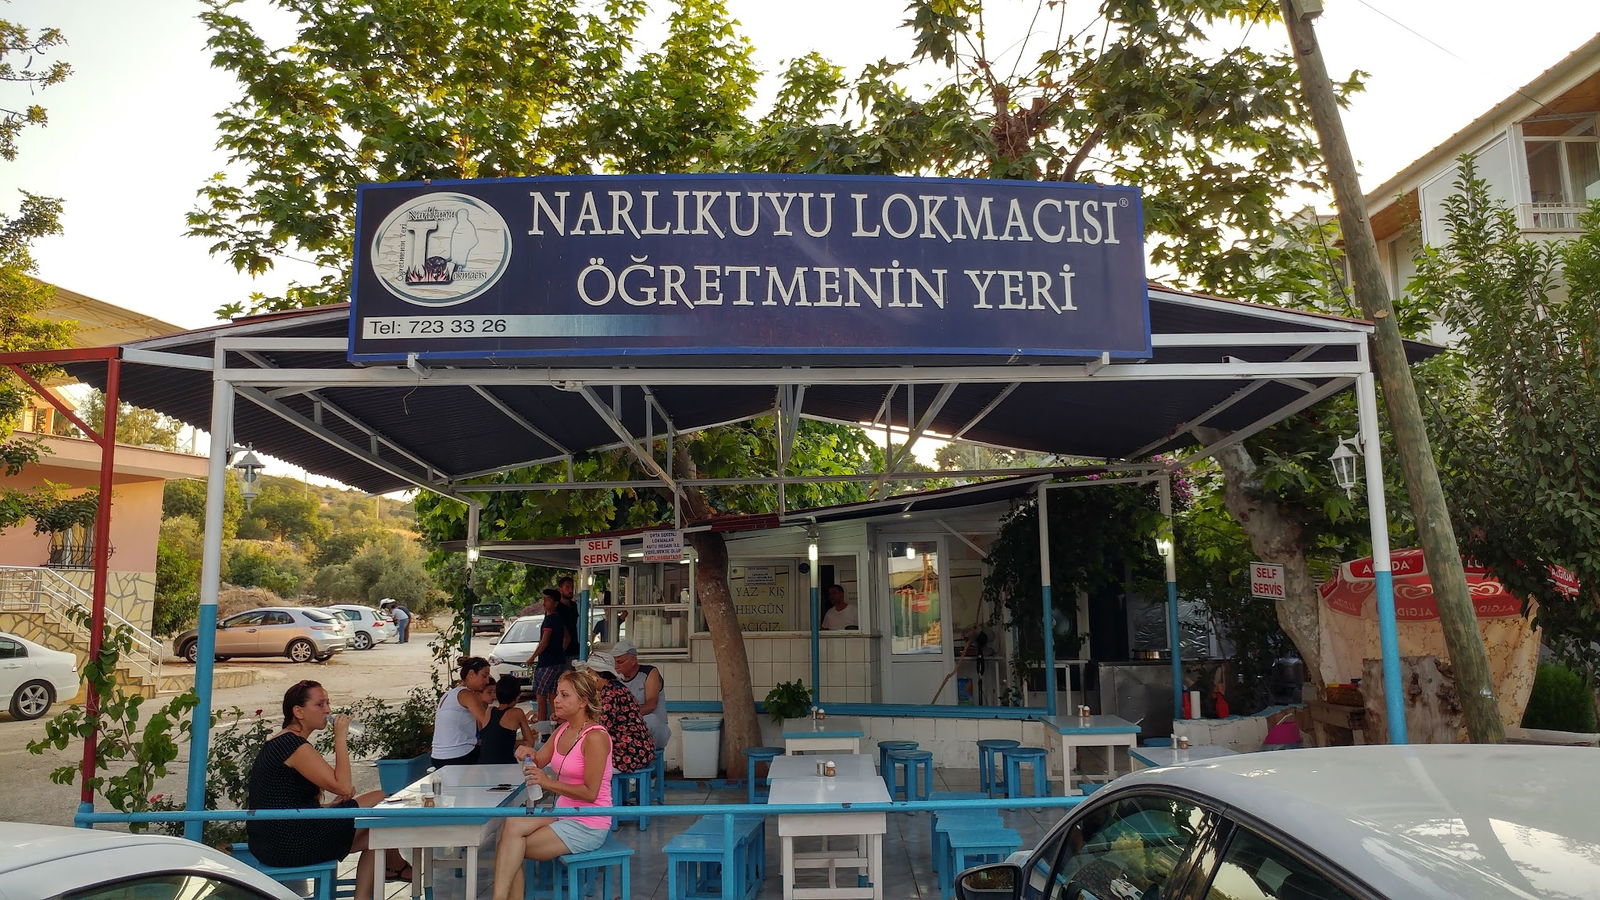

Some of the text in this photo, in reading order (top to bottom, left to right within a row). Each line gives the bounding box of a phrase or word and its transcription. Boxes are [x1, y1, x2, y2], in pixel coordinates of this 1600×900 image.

[528, 190, 836, 240] NARLIKUYU
[576, 254, 1078, 315] ÖĞRETMENİN YERİ
[369, 318, 507, 335] Tel: 723 33 26
[588, 540, 613, 551] SELF
[583, 551, 619, 565] SERVİS
[1256, 567, 1277, 579] SELF
[1362, 560, 1410, 574] ADA
[736, 587, 758, 597] YAZ
[769, 586, 785, 599] KIŞ
[1253, 581, 1283, 596] SERVİS
